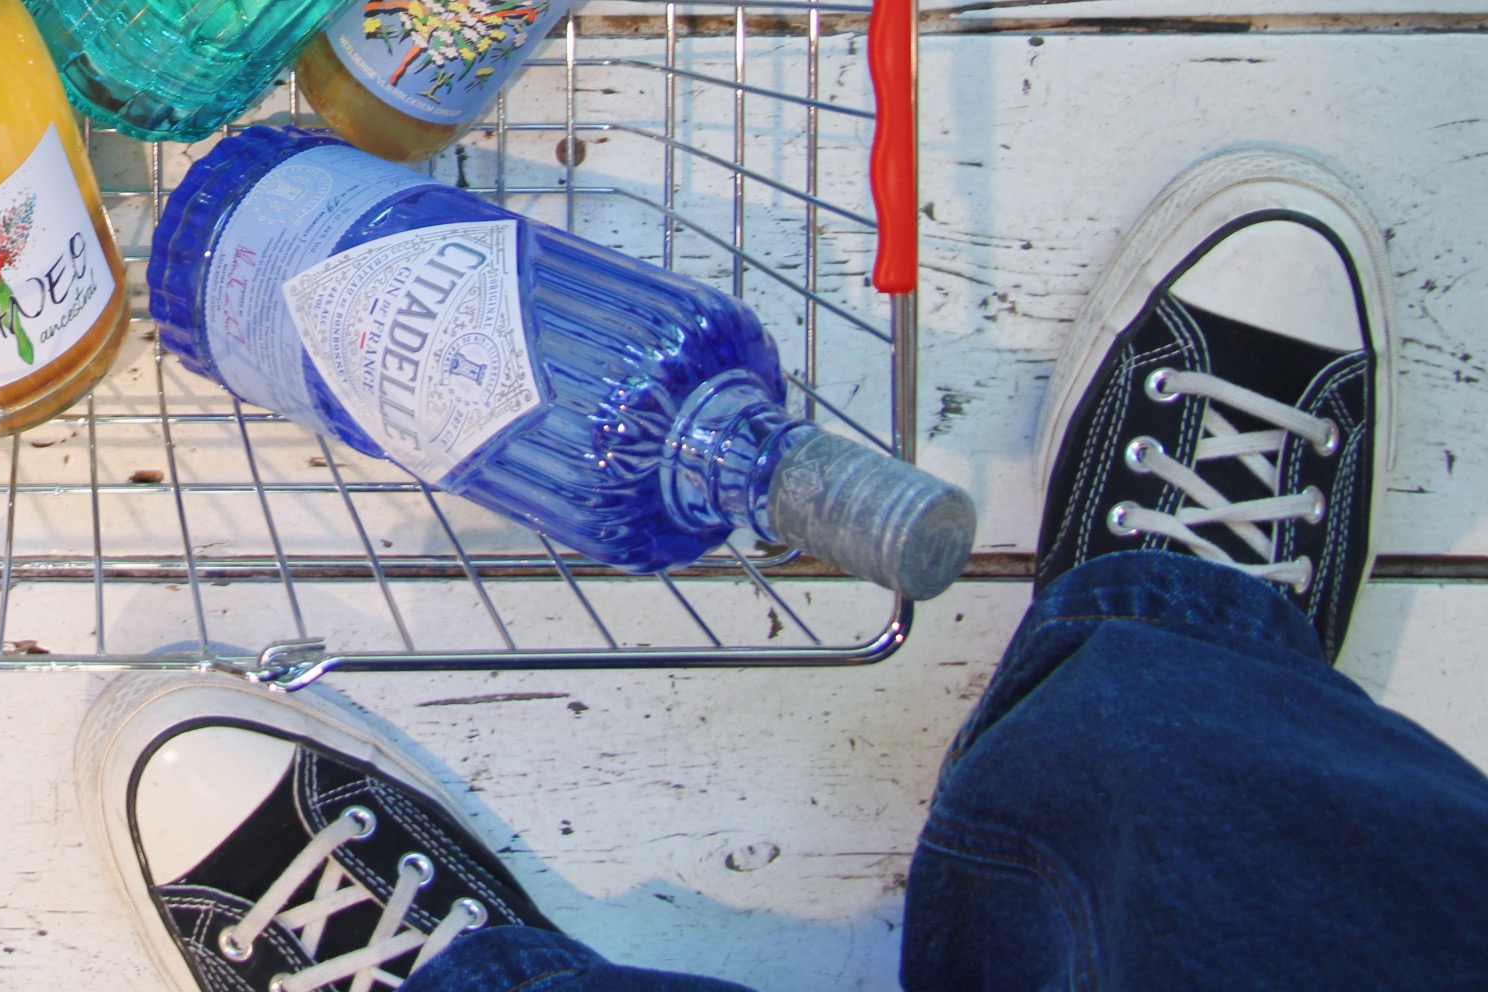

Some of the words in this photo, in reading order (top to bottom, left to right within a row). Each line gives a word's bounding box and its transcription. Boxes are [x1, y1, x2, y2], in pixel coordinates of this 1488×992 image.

[40, 267, 98, 345] ancestral
[378, 299, 391, 317] DE
[386, 266, 412, 299] GIN
[483, 277, 499, 329] ORIGINAL
[362, 319, 386, 395] FRANCE
[378, 241, 487, 452] CITADELLE
